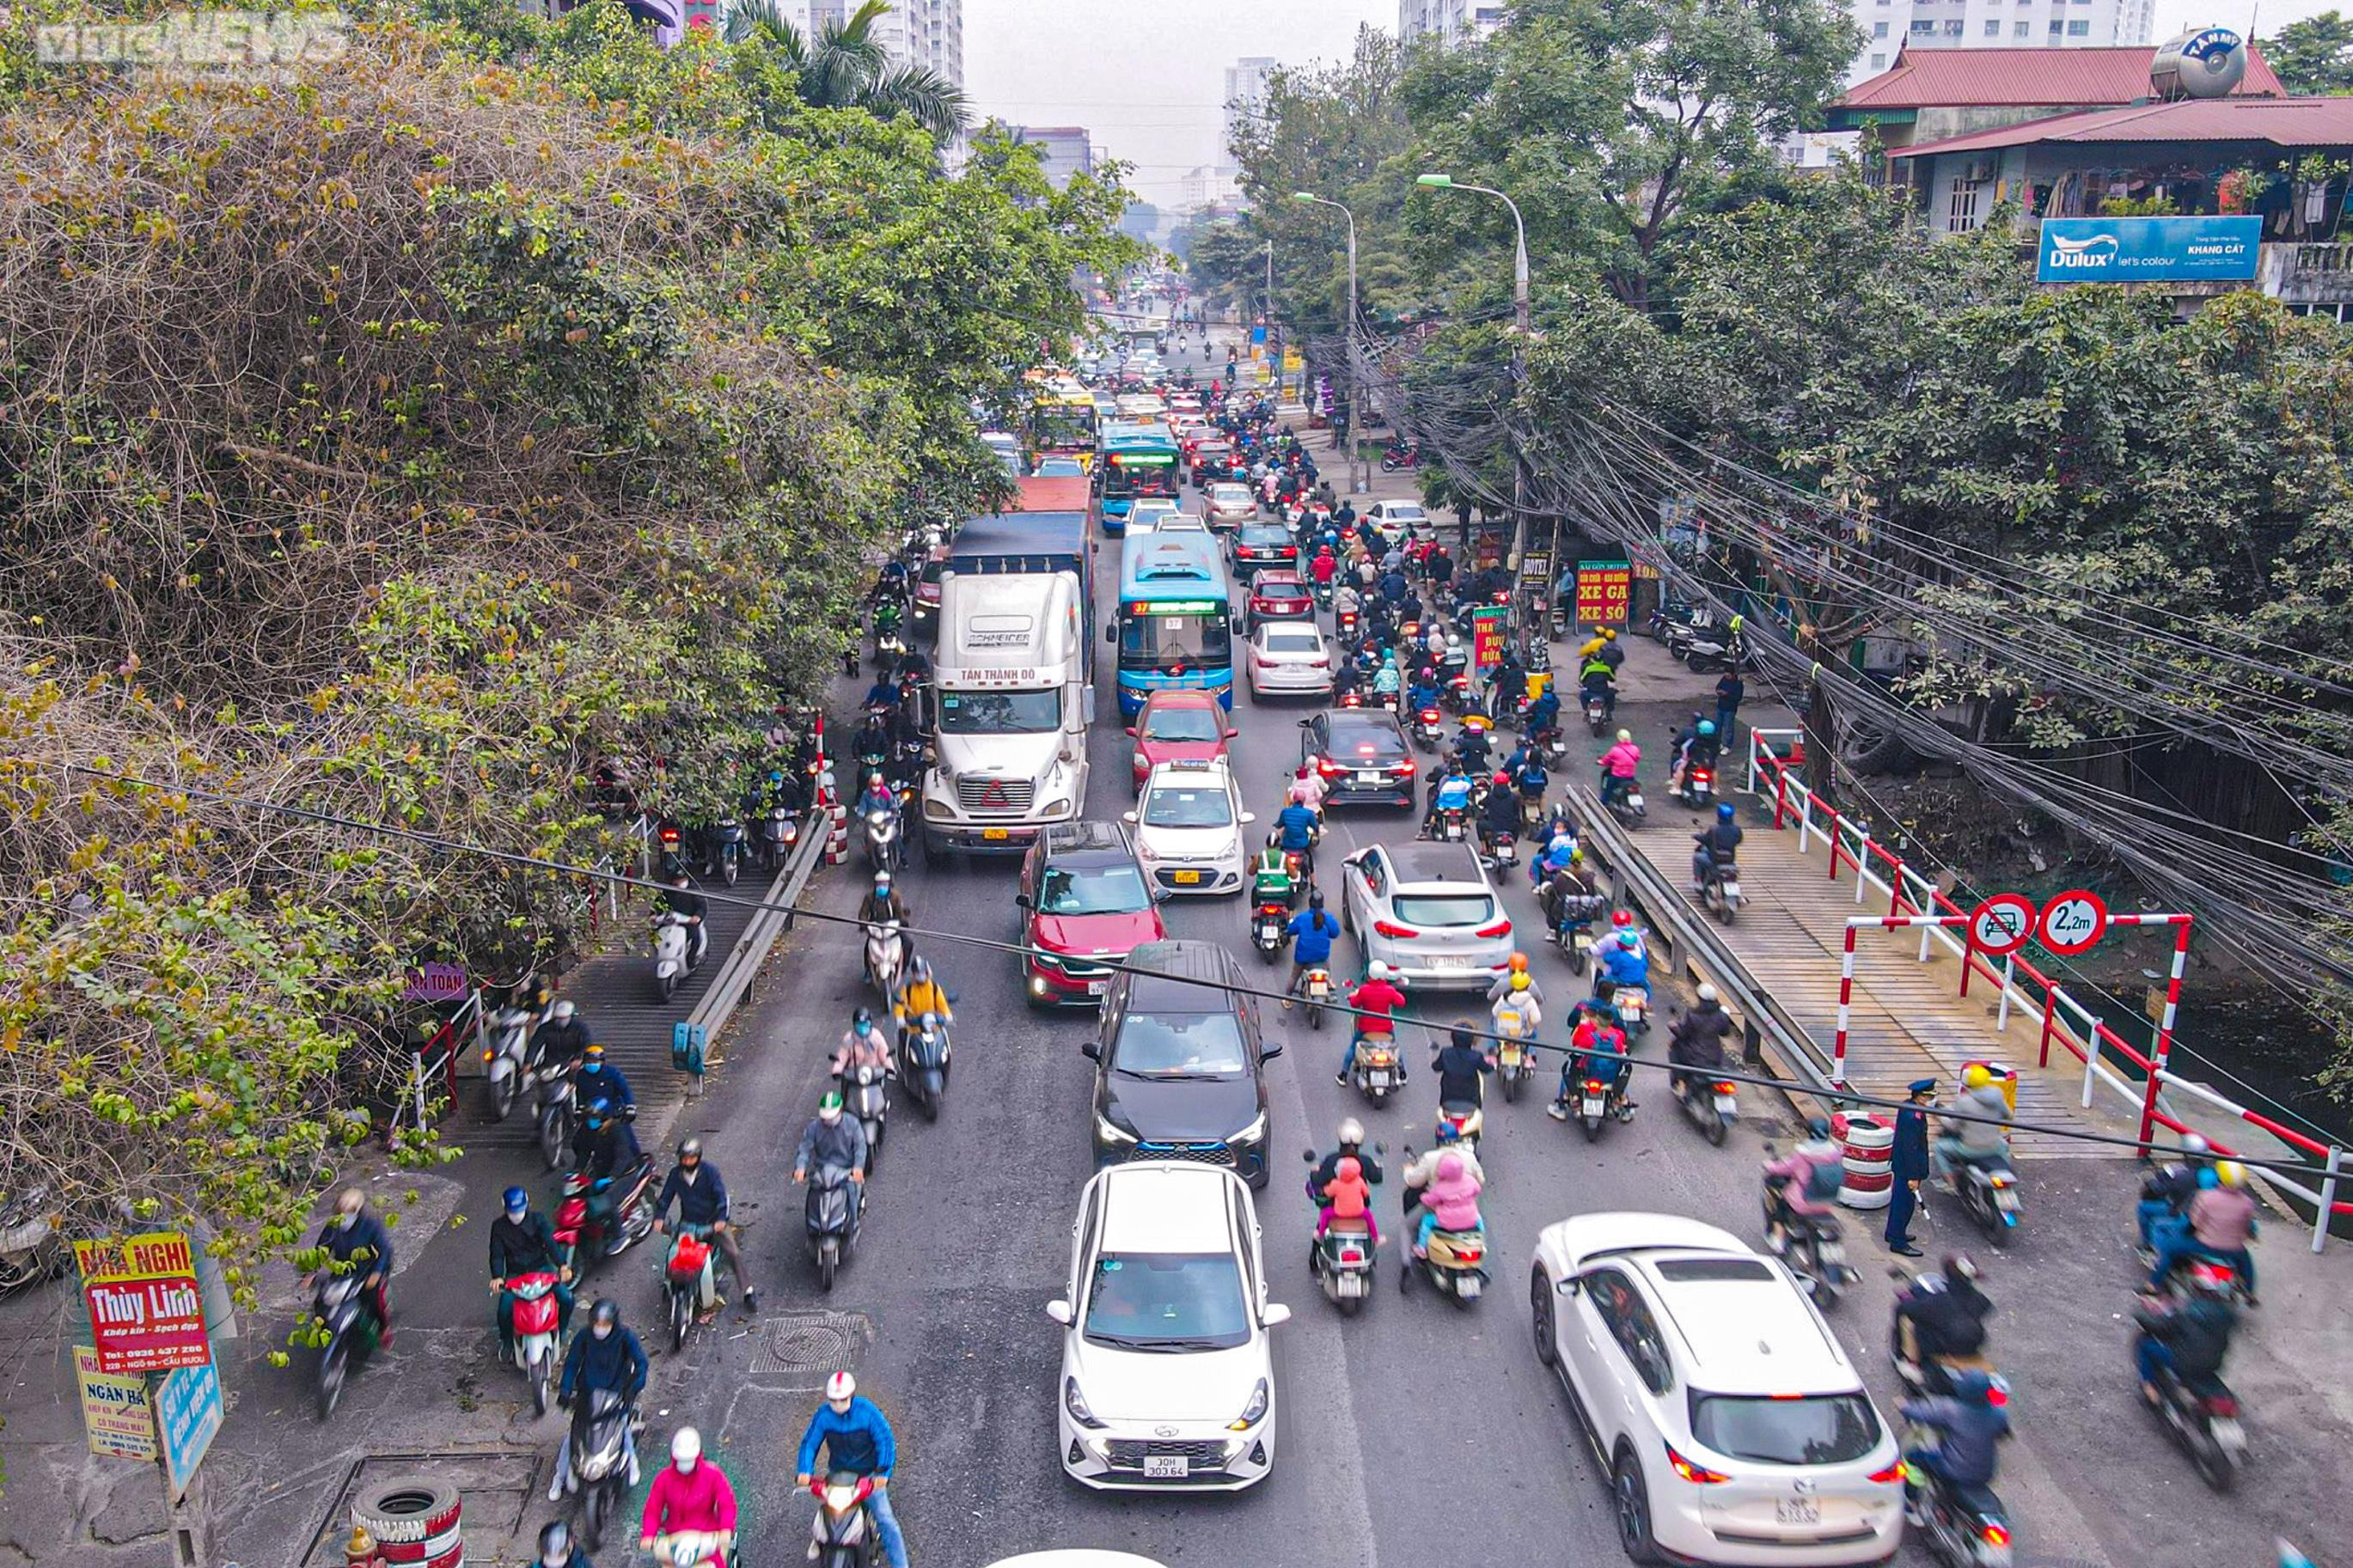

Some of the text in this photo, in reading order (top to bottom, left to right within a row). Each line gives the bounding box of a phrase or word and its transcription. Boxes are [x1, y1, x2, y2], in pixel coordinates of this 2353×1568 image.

[2050, 250, 2107, 267] Dulux
[2188, 246, 2223, 254] KHANG
[2118, 256, 2140, 266] let's
[2141, 256, 2176, 266] colour
[1523, 558, 1547, 575] HOTEL
[1579, 585, 1628, 600] XE GA
[1579, 601, 1625, 620] XE SỐ
[1476, 623, 1494, 632] THA
[2055, 906, 2090, 931] 2,2m
[92, 1283, 199, 1325] Thùy Linh
[104, 1351, 125, 1360] Tel:
[87, 1382, 124, 1402] NGÂN
